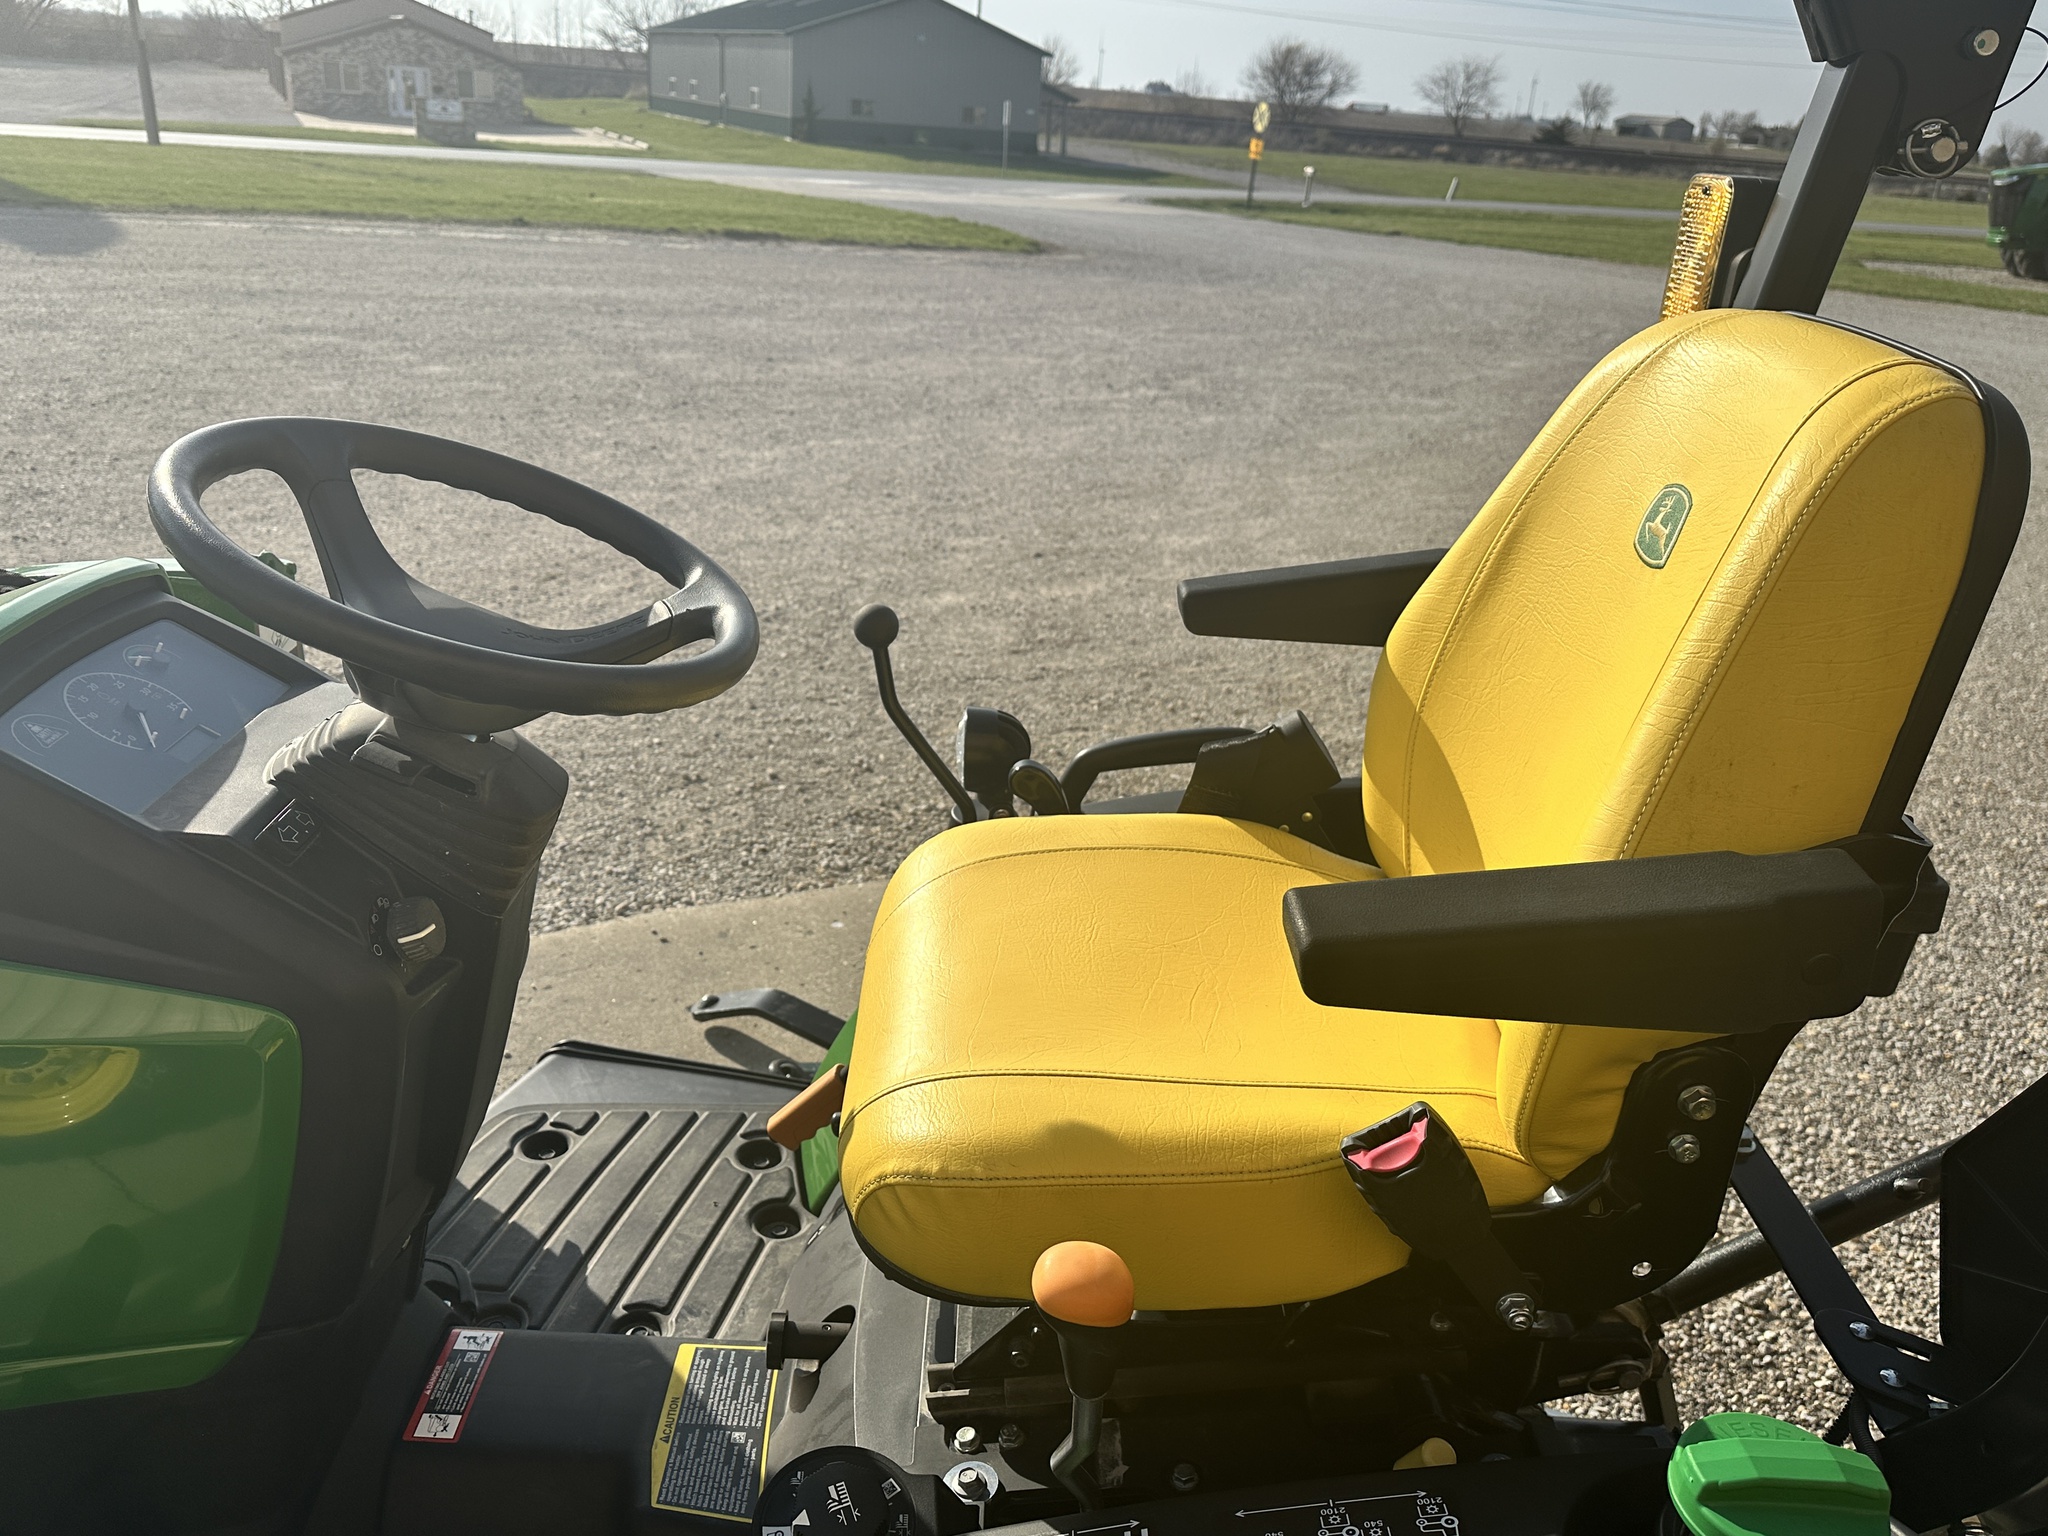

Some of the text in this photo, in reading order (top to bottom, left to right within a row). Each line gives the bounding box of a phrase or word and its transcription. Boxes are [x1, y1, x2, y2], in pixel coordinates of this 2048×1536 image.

[568, 616, 646, 644] DEERE
[86, 682, 100, 692] 20
[113, 680, 126, 690] 25
[139, 687, 152, 697] 30
[77, 695, 89, 704] 15
[166, 703, 179, 712] 35
[87, 711, 99, 720] 10
[111, 729, 122, 737] 5
[427, 1366, 442, 1389] DANGER
[662, 1396, 680, 1434] CAUTION
[1416, 1496, 1443, 1506] 2100
[1320, 1506, 1346, 1516] 2100
[1364, 1520, 1384, 1528] 540
